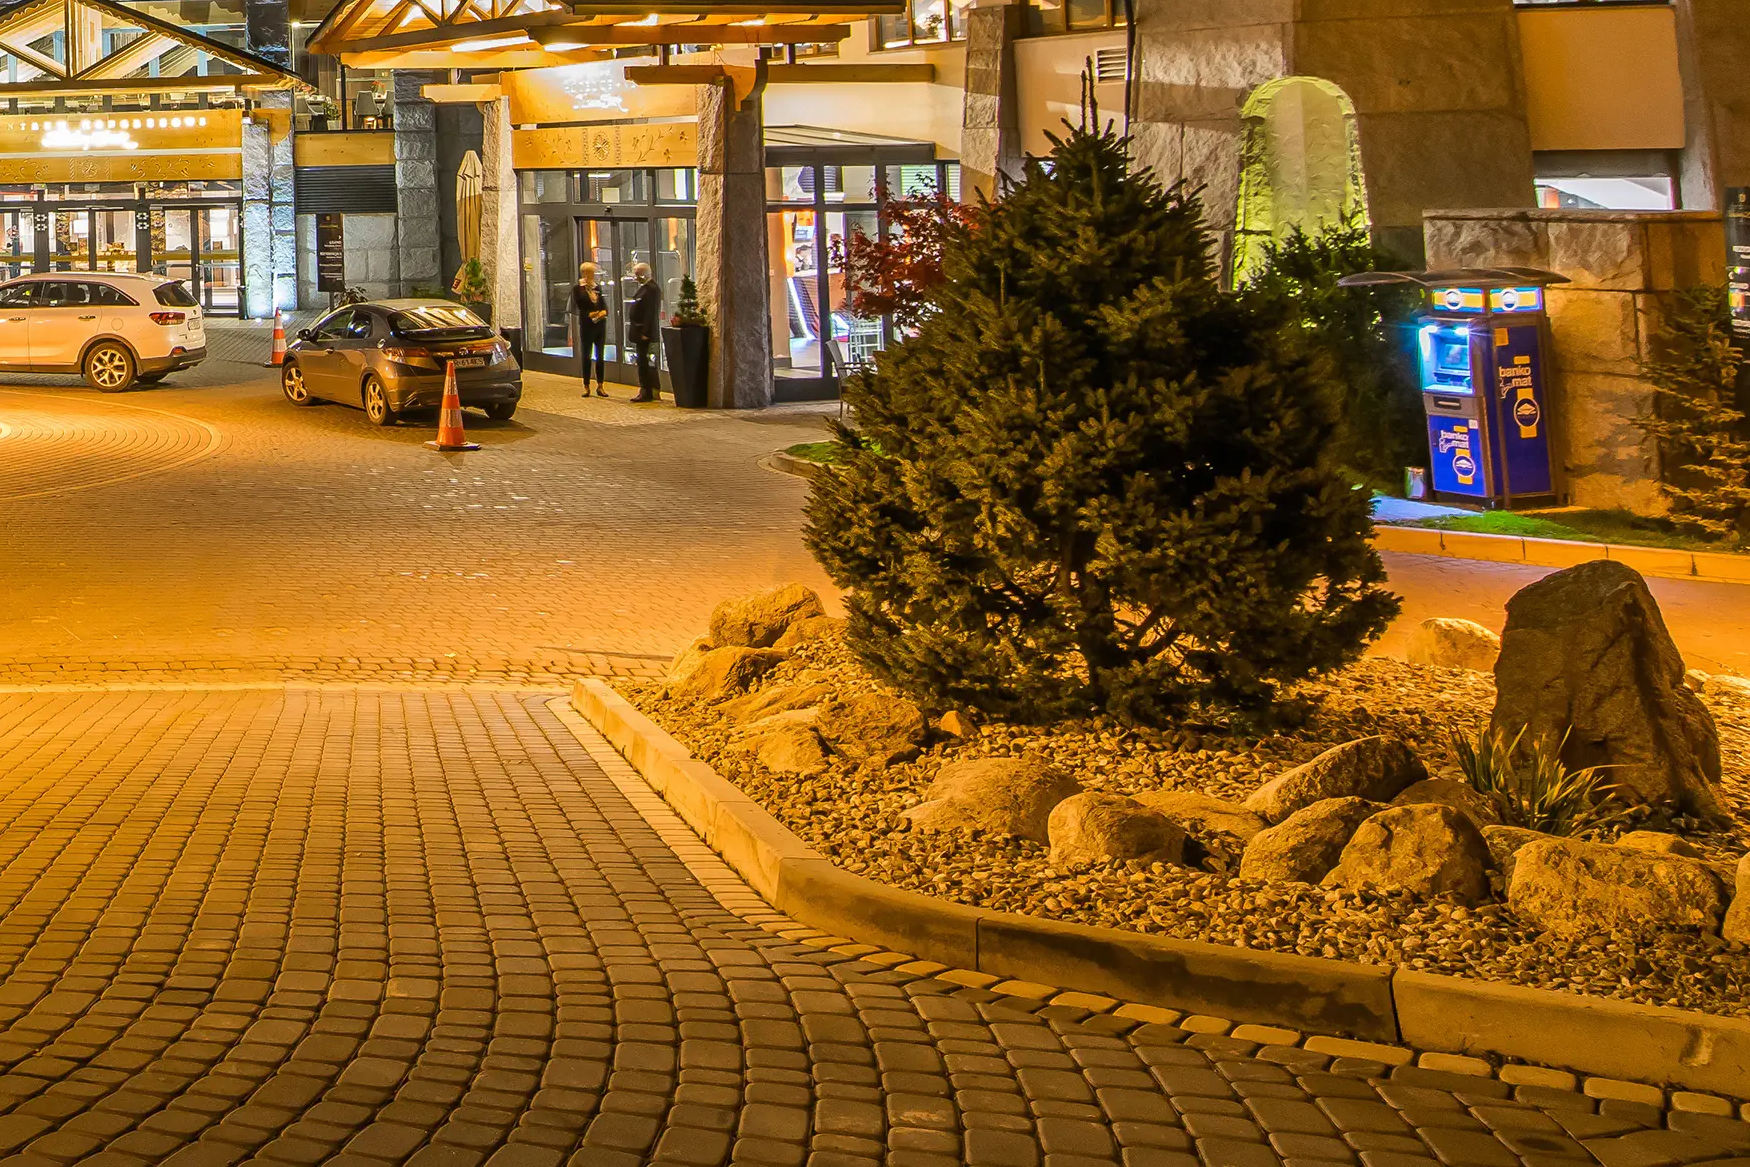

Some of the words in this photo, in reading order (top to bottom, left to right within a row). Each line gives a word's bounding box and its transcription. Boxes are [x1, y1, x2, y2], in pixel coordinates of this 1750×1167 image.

[1498, 365, 1532, 377] banko
[1512, 376, 1533, 387] mat
[1440, 430, 1469, 441] banko
[1452, 440, 1470, 449] mat
